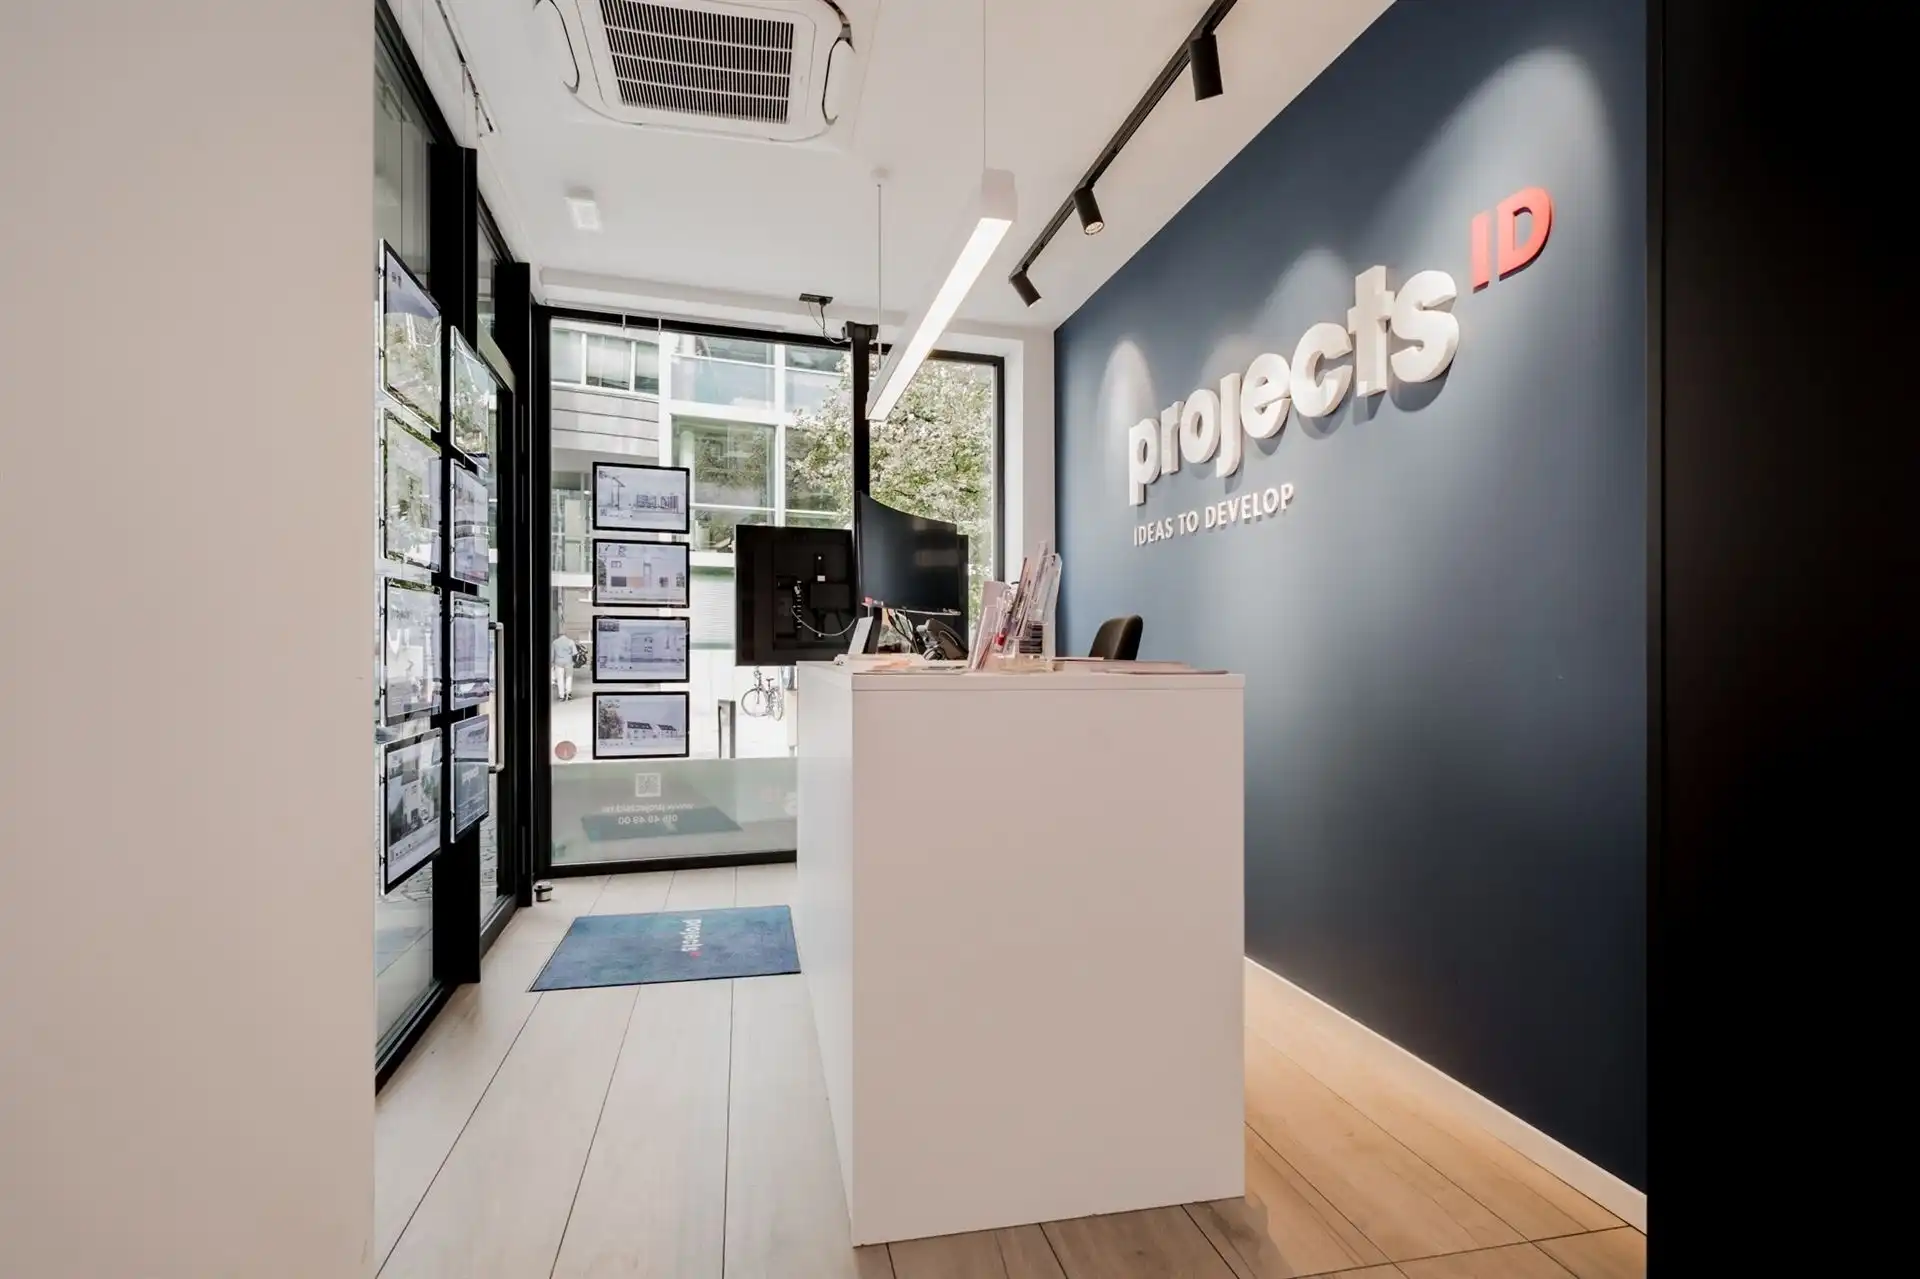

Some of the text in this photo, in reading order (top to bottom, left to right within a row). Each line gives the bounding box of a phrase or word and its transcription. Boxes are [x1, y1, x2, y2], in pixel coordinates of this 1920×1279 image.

[1128, 186, 1553, 506] projects ID
[1133, 483, 1294, 547] IDEAS TO DEVELOP
